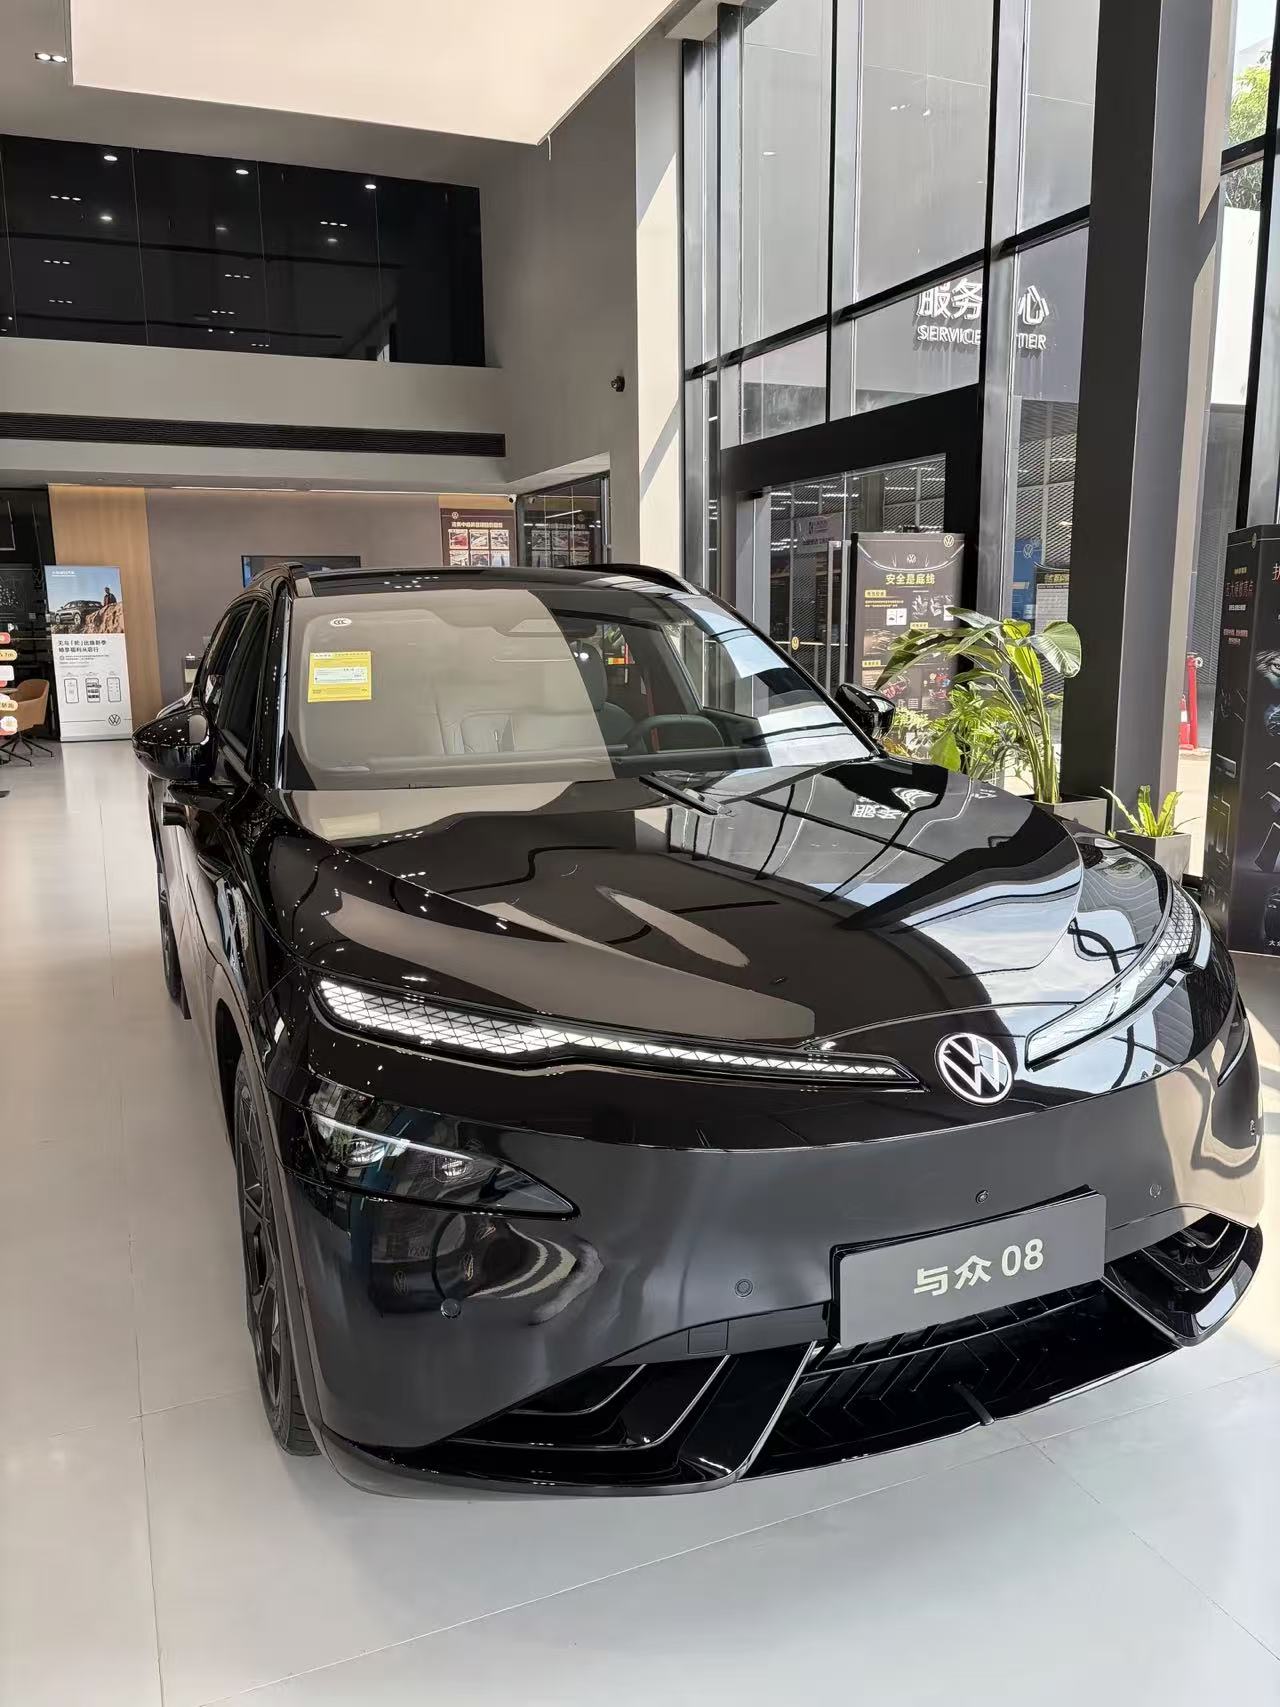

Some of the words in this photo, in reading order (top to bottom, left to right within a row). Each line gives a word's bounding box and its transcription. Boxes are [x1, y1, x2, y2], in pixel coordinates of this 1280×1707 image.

[916, 278, 1049, 325] 服务心
[885, 573, 936, 585] 安全是底线
[913, 1254, 993, 1297] 与众
[1001, 1238, 1044, 1277] 08
